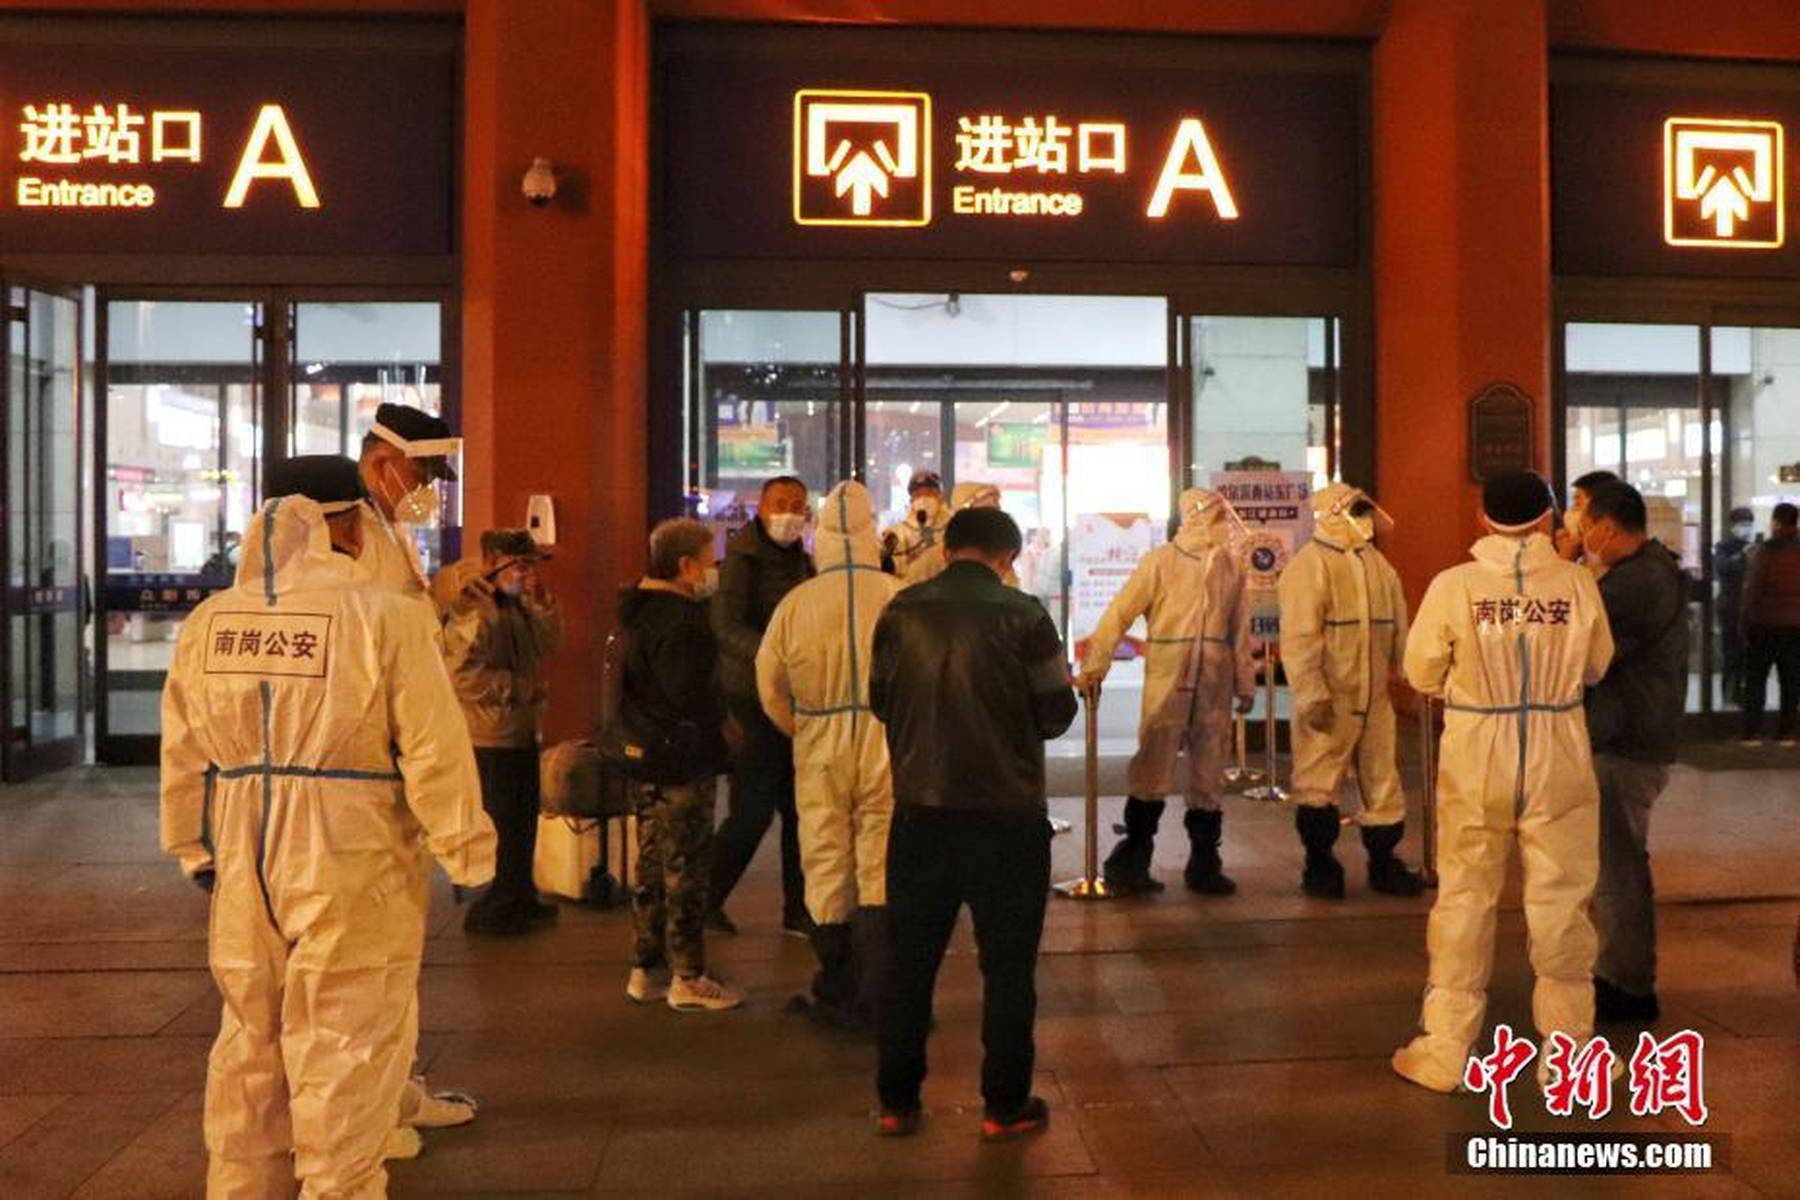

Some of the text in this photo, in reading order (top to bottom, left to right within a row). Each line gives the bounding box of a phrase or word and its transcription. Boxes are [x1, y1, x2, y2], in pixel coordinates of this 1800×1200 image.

[19, 103, 320, 208] 进站口 A
[955, 115, 1239, 219] 进站口 A
[17, 177, 156, 208] Entrance
[953, 186, 1084, 216] Entrance
[1473, 598, 1571, 625] 南岗公安
[213, 628, 318, 659] 南岗公安
